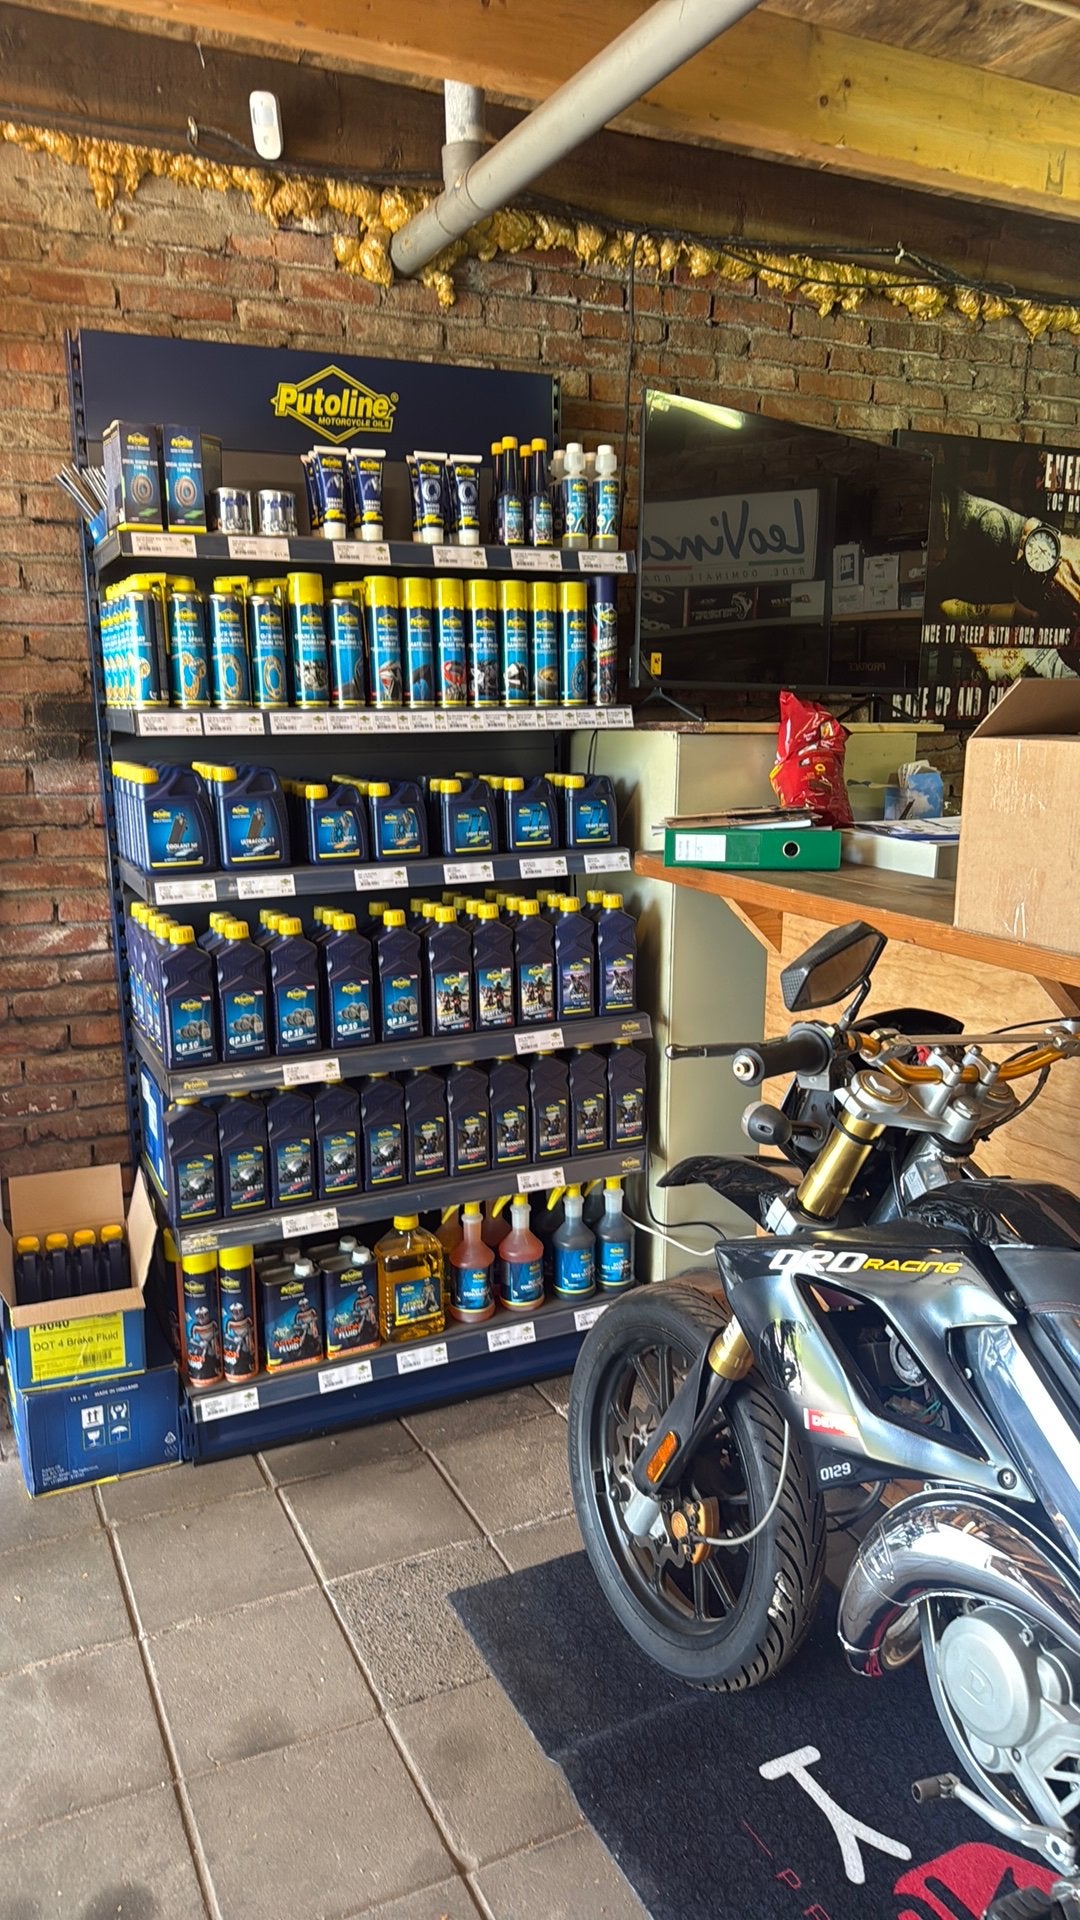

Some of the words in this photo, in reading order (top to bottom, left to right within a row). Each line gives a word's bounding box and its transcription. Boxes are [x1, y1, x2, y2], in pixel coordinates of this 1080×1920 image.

[279, 383, 390, 418] Putoline
[319, 417, 371, 428] MOTORCYCLE
[372, 419, 390, 429] OILS
[945, 625, 956, 644] TO
[960, 625, 985, 644] SLEEP
[988, 627, 1010, 645] WITH
[1014, 627, 1035, 645] YOUR
[1038, 628, 1071, 646] DREAMS
[935, 686, 952, 717] UP
[957, 687, 982, 717] AND
[387, 1018, 398, 1027] GP
[399, 1015, 407, 1025] 10
[282, 1030, 293, 1039] GP
[294, 1028, 303, 1036] 10
[337, 1024, 348, 1033] GP
[348, 1022, 358, 1030] 10
[229, 1036, 241, 1046] GP
[241, 1034, 251, 1043] 10
[176, 1043, 188, 1053] GP
[189, 1041, 199, 1049] 10
[769, 1249, 869, 1274] DRD
[863, 1258, 963, 1274] RACING
[338, 1329, 358, 1340] FLUID
[33, 1339, 56, 1352] DOT
[58, 1339, 64, 1347] 4
[67, 1336, 94, 1347] Brake
[97, 1331, 119, 1342] Fluid
[279, 1342, 300, 1354] FLUID
[820, 1462, 852, 1481] 0129
